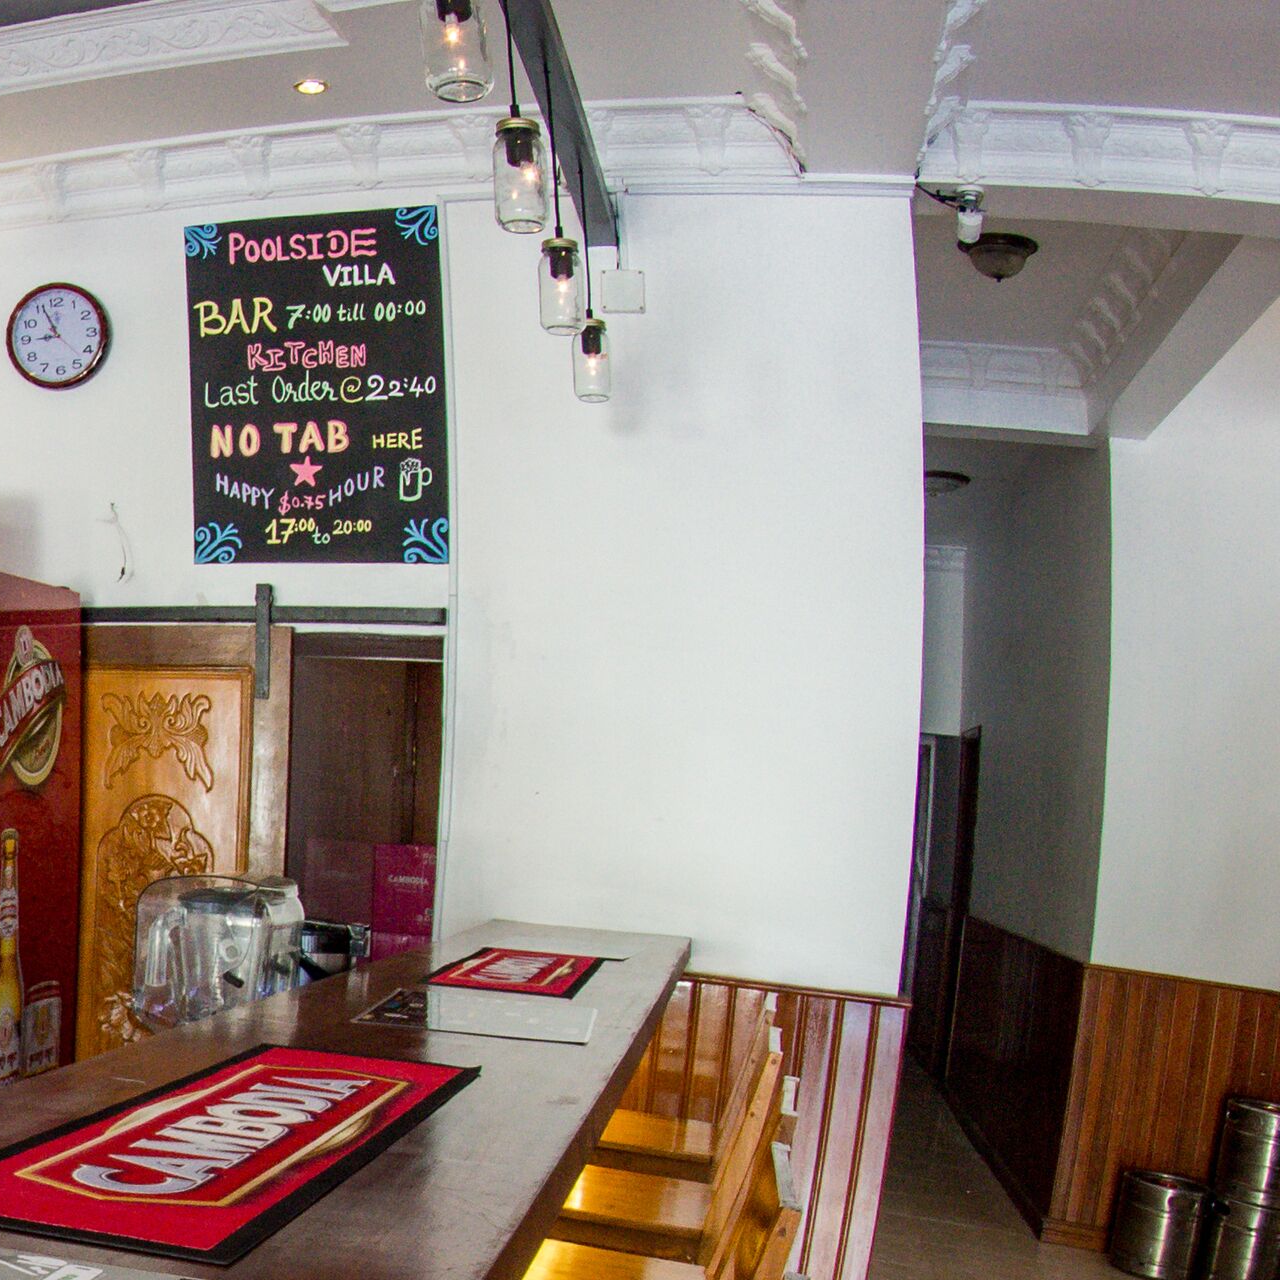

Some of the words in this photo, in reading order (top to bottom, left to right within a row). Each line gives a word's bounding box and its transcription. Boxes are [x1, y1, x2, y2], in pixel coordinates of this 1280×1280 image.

[228, 228, 377, 265] POOLSIDE
[323, 263, 396, 288] VILLA
[49, 297, 64, 308] 12
[80, 310, 92, 321] 2
[194, 296, 278, 338] BAR
[286, 304, 332, 330] 7:00
[336, 302, 366, 323] till
[374, 299, 426, 323] 00:00
[23, 319, 38, 329] 10
[85, 327, 98, 338] 3
[21, 335, 32, 345] 9
[82, 345, 95, 355] 4
[247, 339, 367, 372] KITCHEN
[27, 351, 38, 362] 8
[40, 362, 50, 373] 7
[72, 359, 83, 370] 5
[56, 365, 67, 376] 6
[205, 375, 260, 408] Last
[272, 371, 338, 403] Order
[209, 423, 261, 459] NO
[273, 419, 351, 454] TAB
[372, 428, 424, 450] HERE
[215, 473, 274, 510] HAPPY
[328, 465, 385, 507] HOUR
[265, 517, 316, 545] 17:00
[312, 525, 331, 546] to
[332, 518, 372, 535] 20:00
[72, 1075, 372, 1194] CAMBODIA
